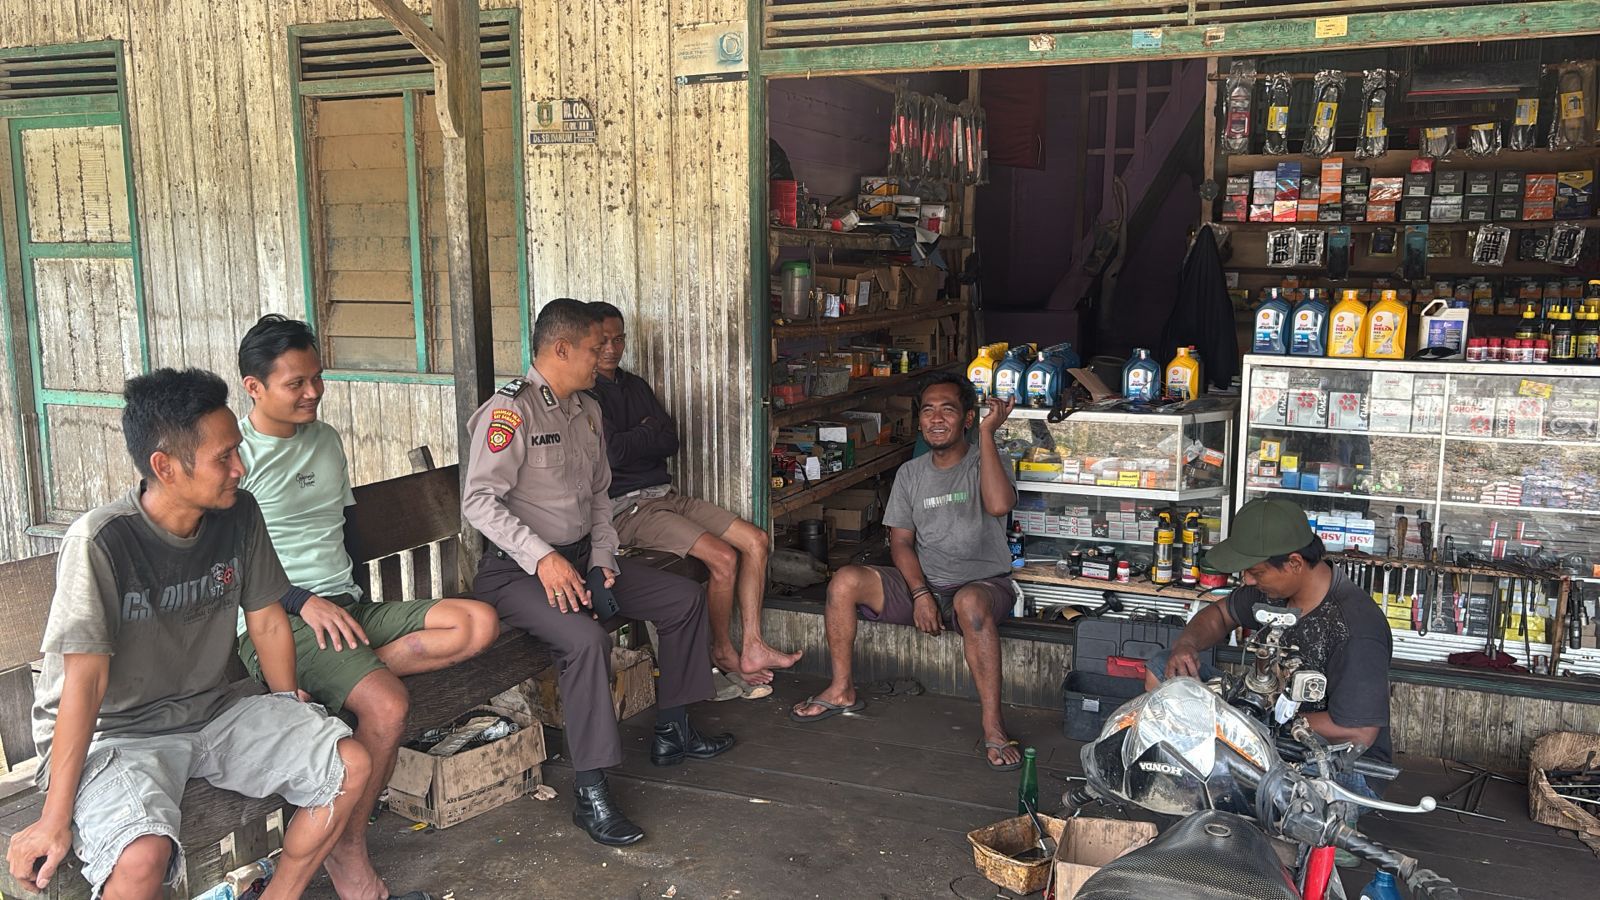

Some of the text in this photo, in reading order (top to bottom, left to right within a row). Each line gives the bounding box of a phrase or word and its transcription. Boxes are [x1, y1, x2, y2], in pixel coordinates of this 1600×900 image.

[531, 433, 561, 447] KARYO
[1321, 532, 1342, 541] ASB
[1139, 762, 1183, 777] HONDA
